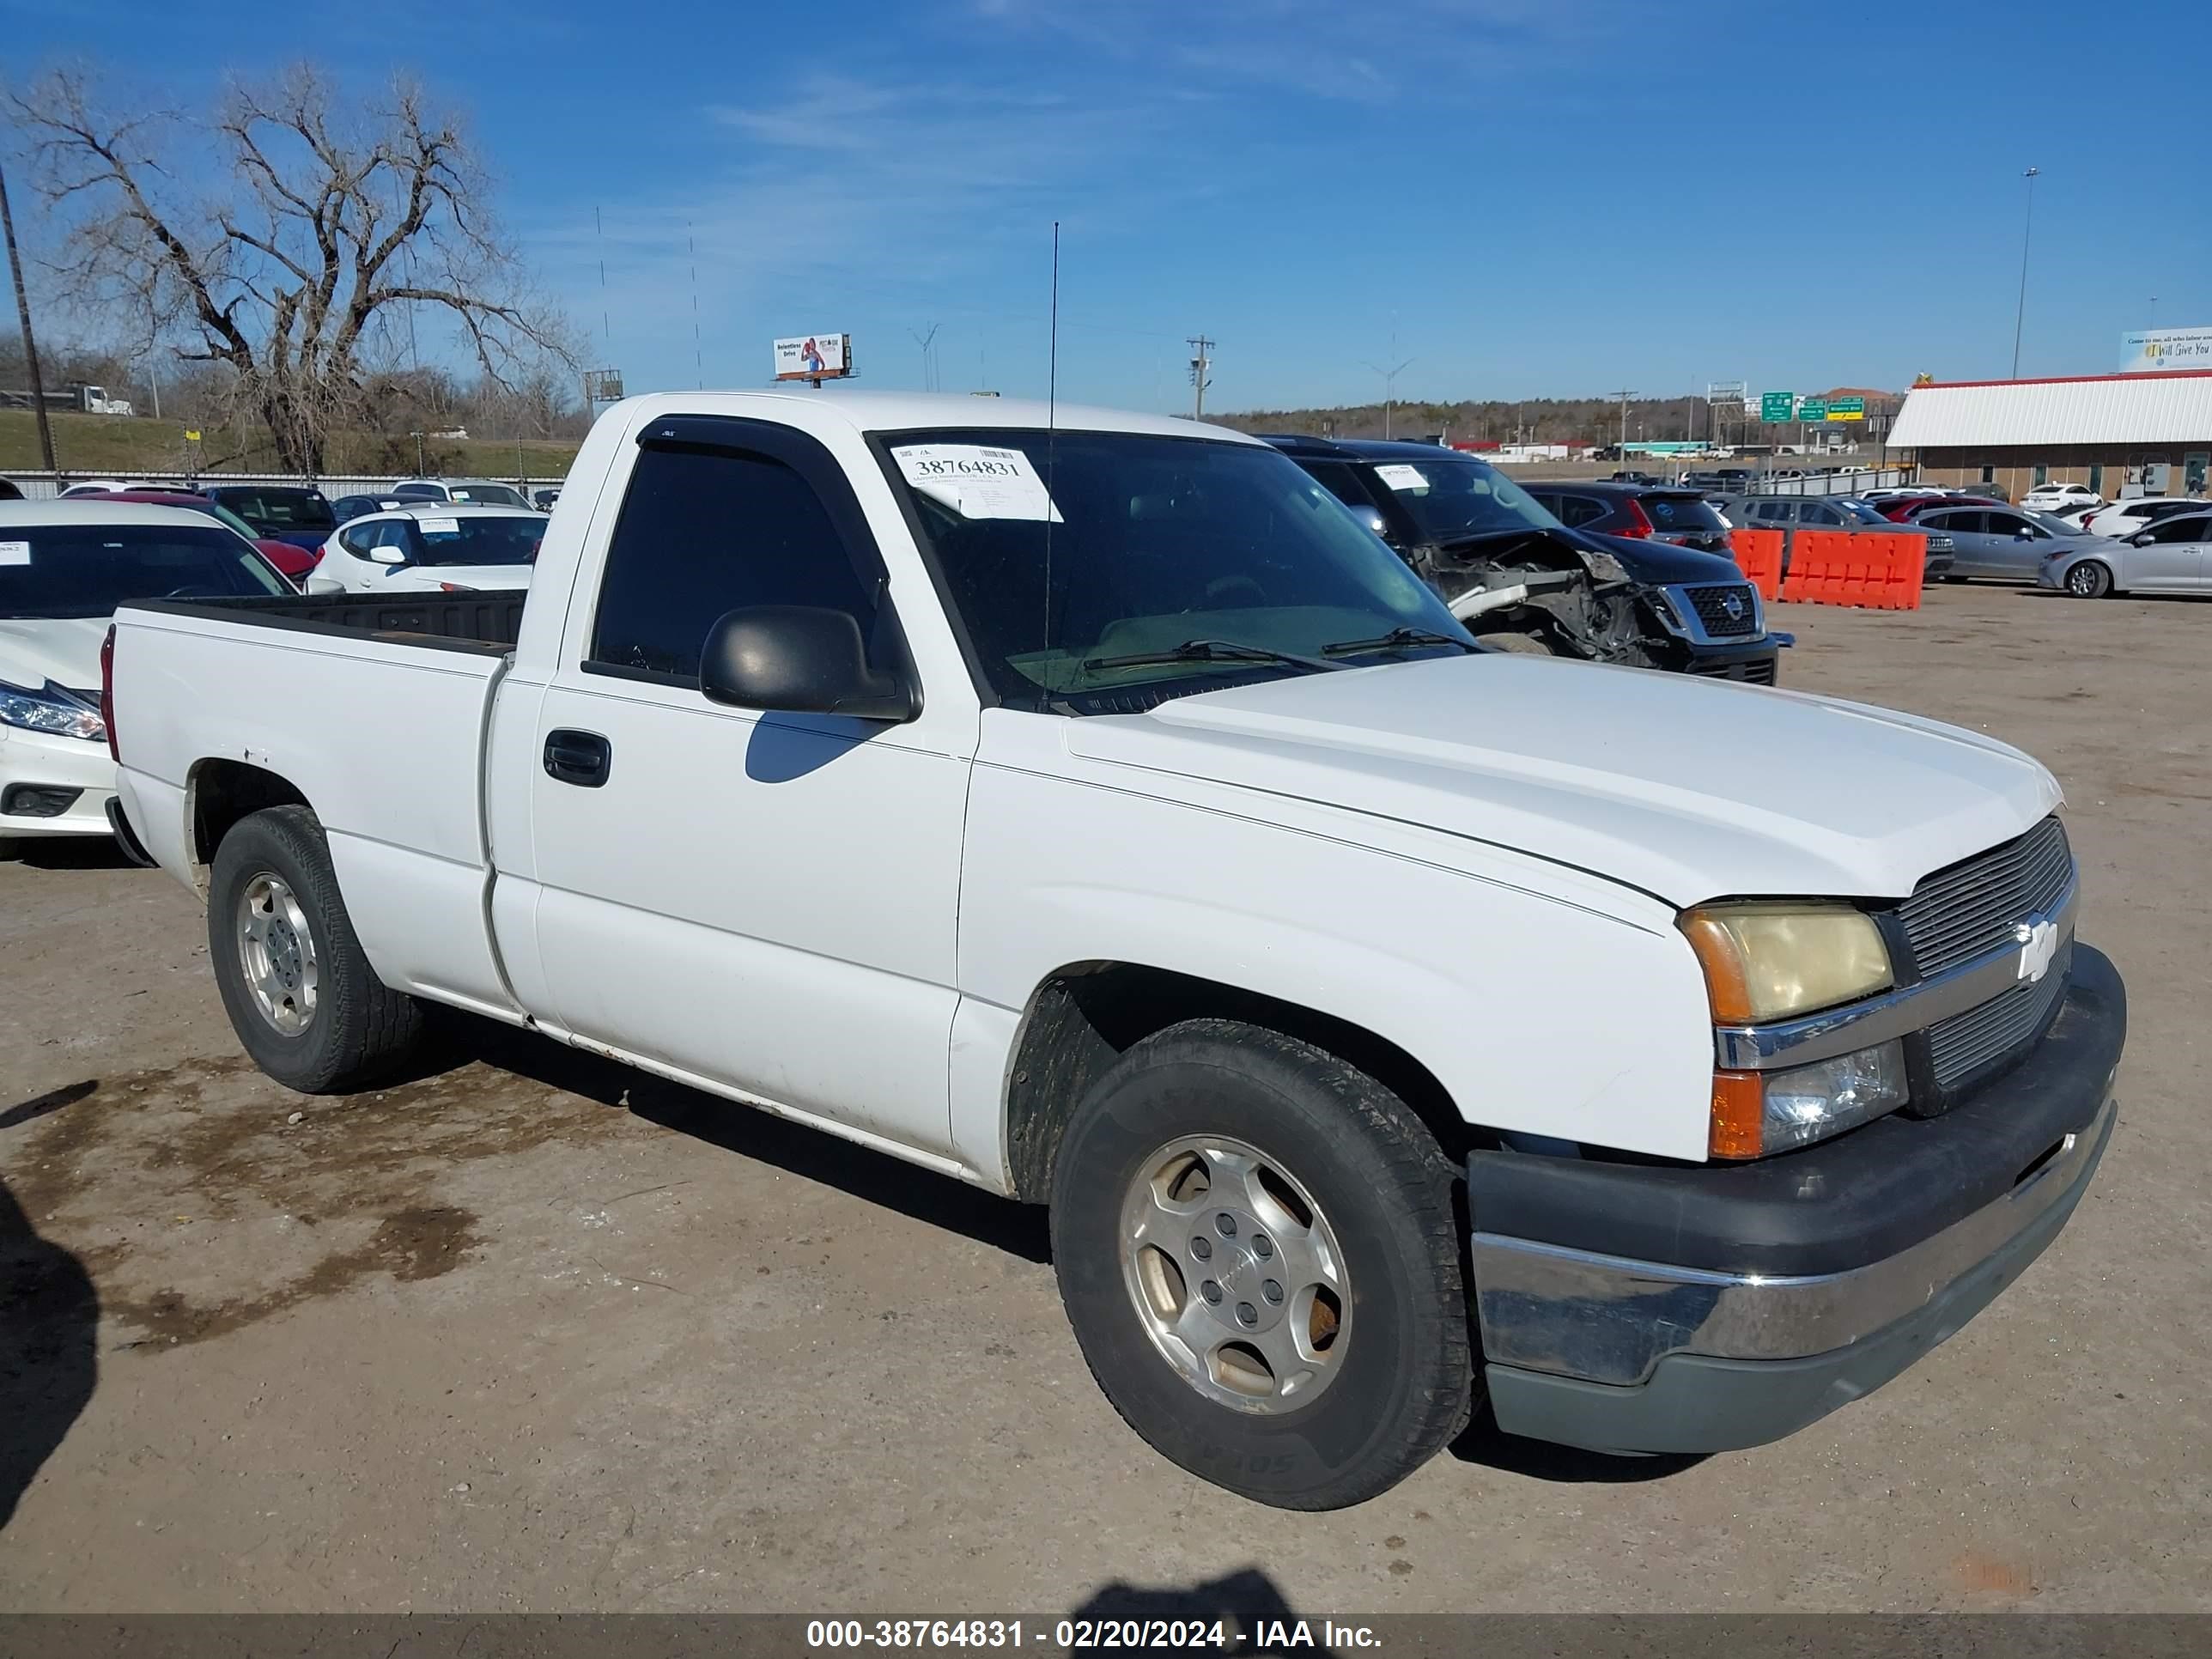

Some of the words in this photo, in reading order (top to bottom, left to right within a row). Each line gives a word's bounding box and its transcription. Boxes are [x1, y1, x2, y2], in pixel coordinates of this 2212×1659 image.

[2158, 343, 2173, 357] Will
[2175, 343, 2192, 356] Give
[2195, 342, 2210, 356] You
[915, 459, 1020, 477] 38764831
